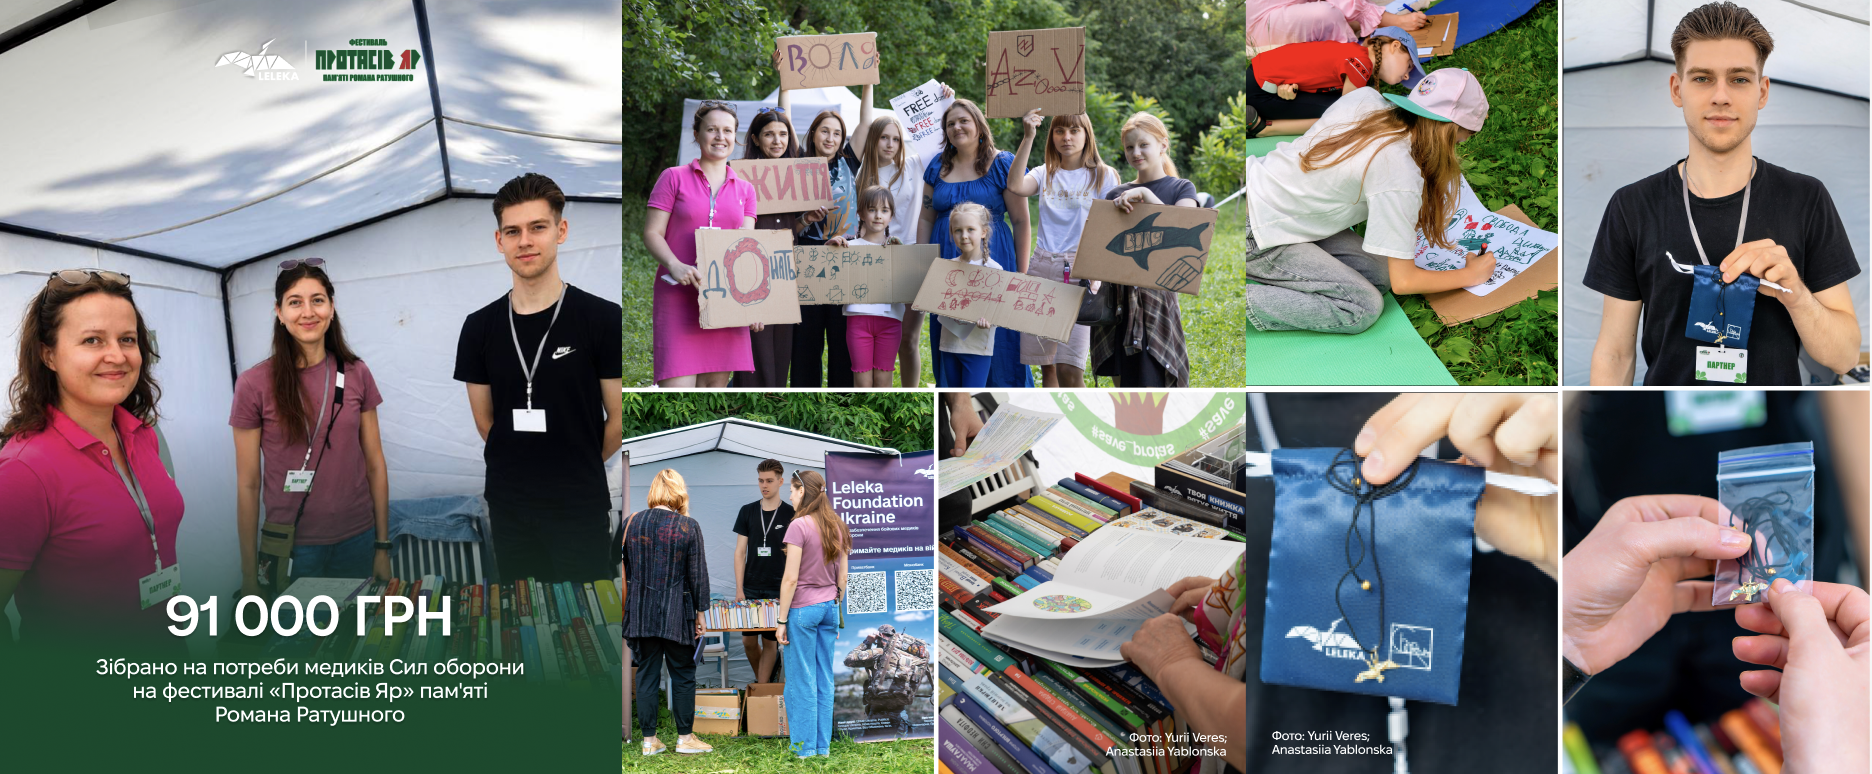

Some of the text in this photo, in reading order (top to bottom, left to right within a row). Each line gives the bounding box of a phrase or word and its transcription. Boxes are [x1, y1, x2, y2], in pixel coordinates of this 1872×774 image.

[903, 94, 934, 117] FREE
[914, 117, 934, 131] FREE
[740, 163, 834, 202] ЖИТТЯ
[1706, 360, 1736, 370] ПАРТНЕР
[832, 480, 884, 494] Leleka
[833, 495, 924, 510] Foundation
[1187, 488, 1244, 514] ТВОЯ КНИЖКА
[883, 545, 913, 554] медиків
[1325, 647, 1366, 661] LELEKA
[942, 739, 962, 758] ГЛУША
[977, 736, 990, 749] СНИ
[959, 755, 976, 772] МАЛА
